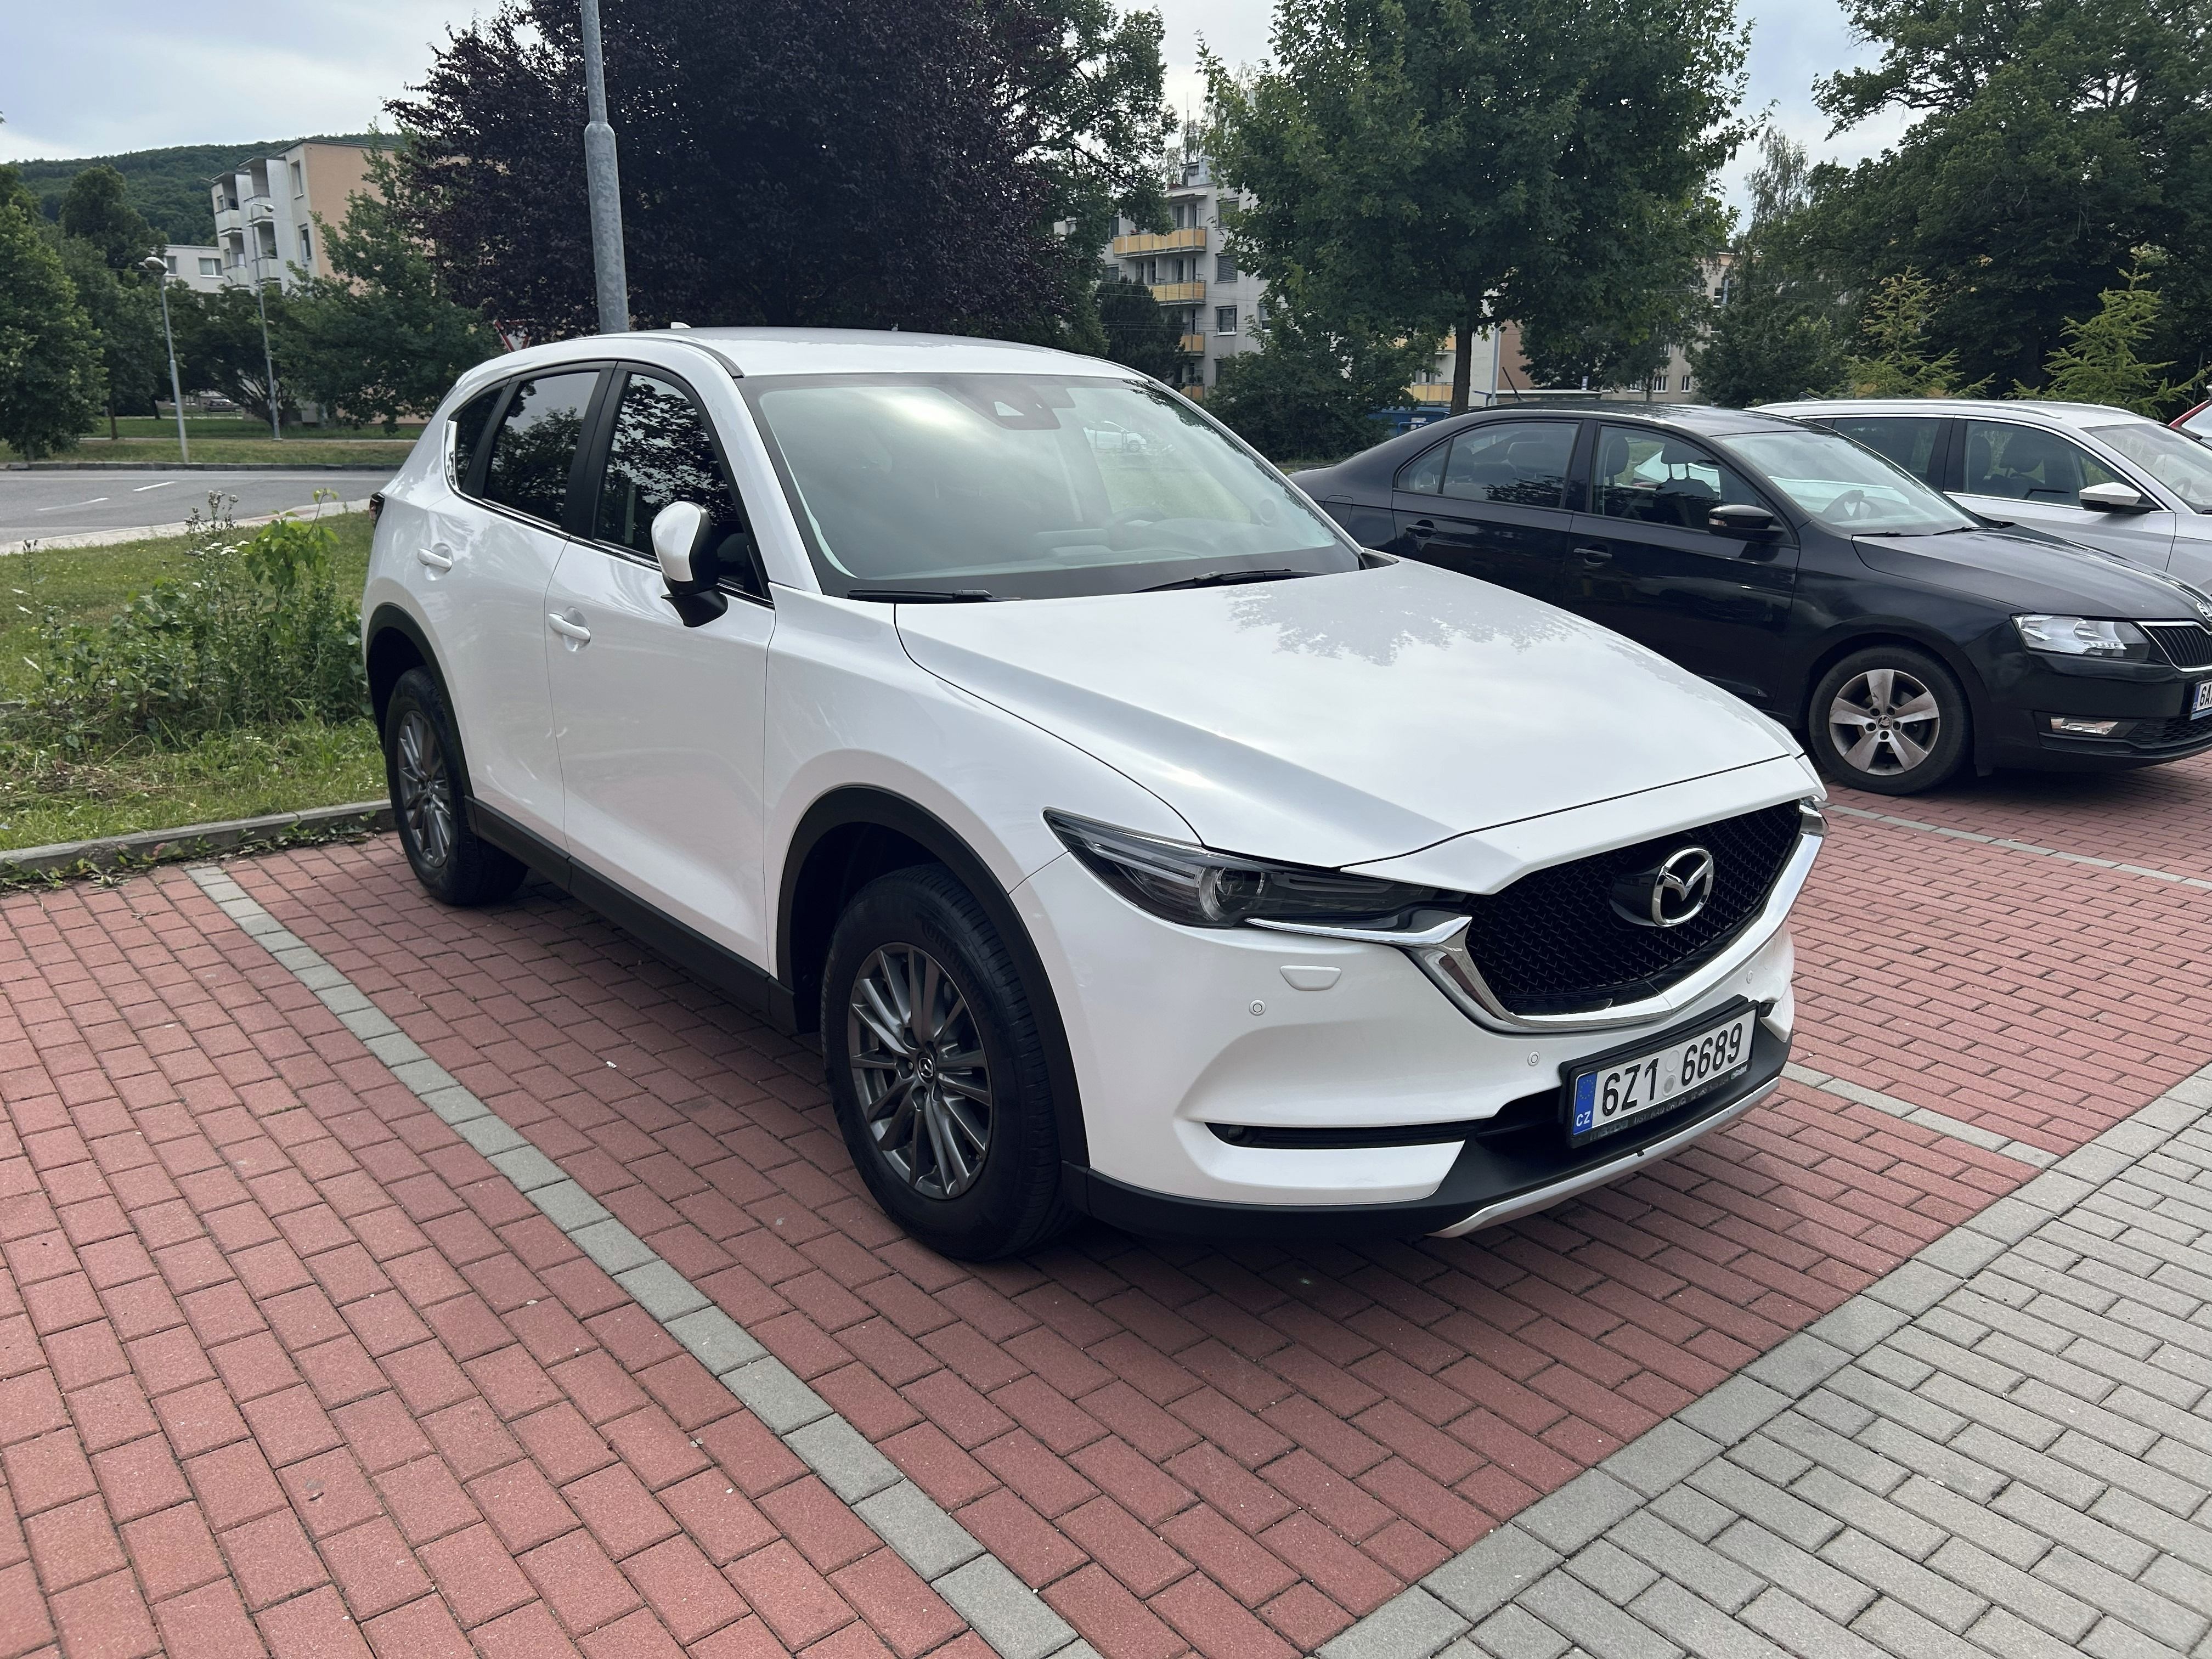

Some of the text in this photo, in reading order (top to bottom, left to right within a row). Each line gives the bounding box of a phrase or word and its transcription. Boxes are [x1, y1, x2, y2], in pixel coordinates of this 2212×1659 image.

[2199, 684, 2212, 707] 6A
[1602, 1058, 1658, 1116] 6Z1
[1681, 1023, 1742, 1086] 6689
[1576, 1110, 1590, 1127] CZ
